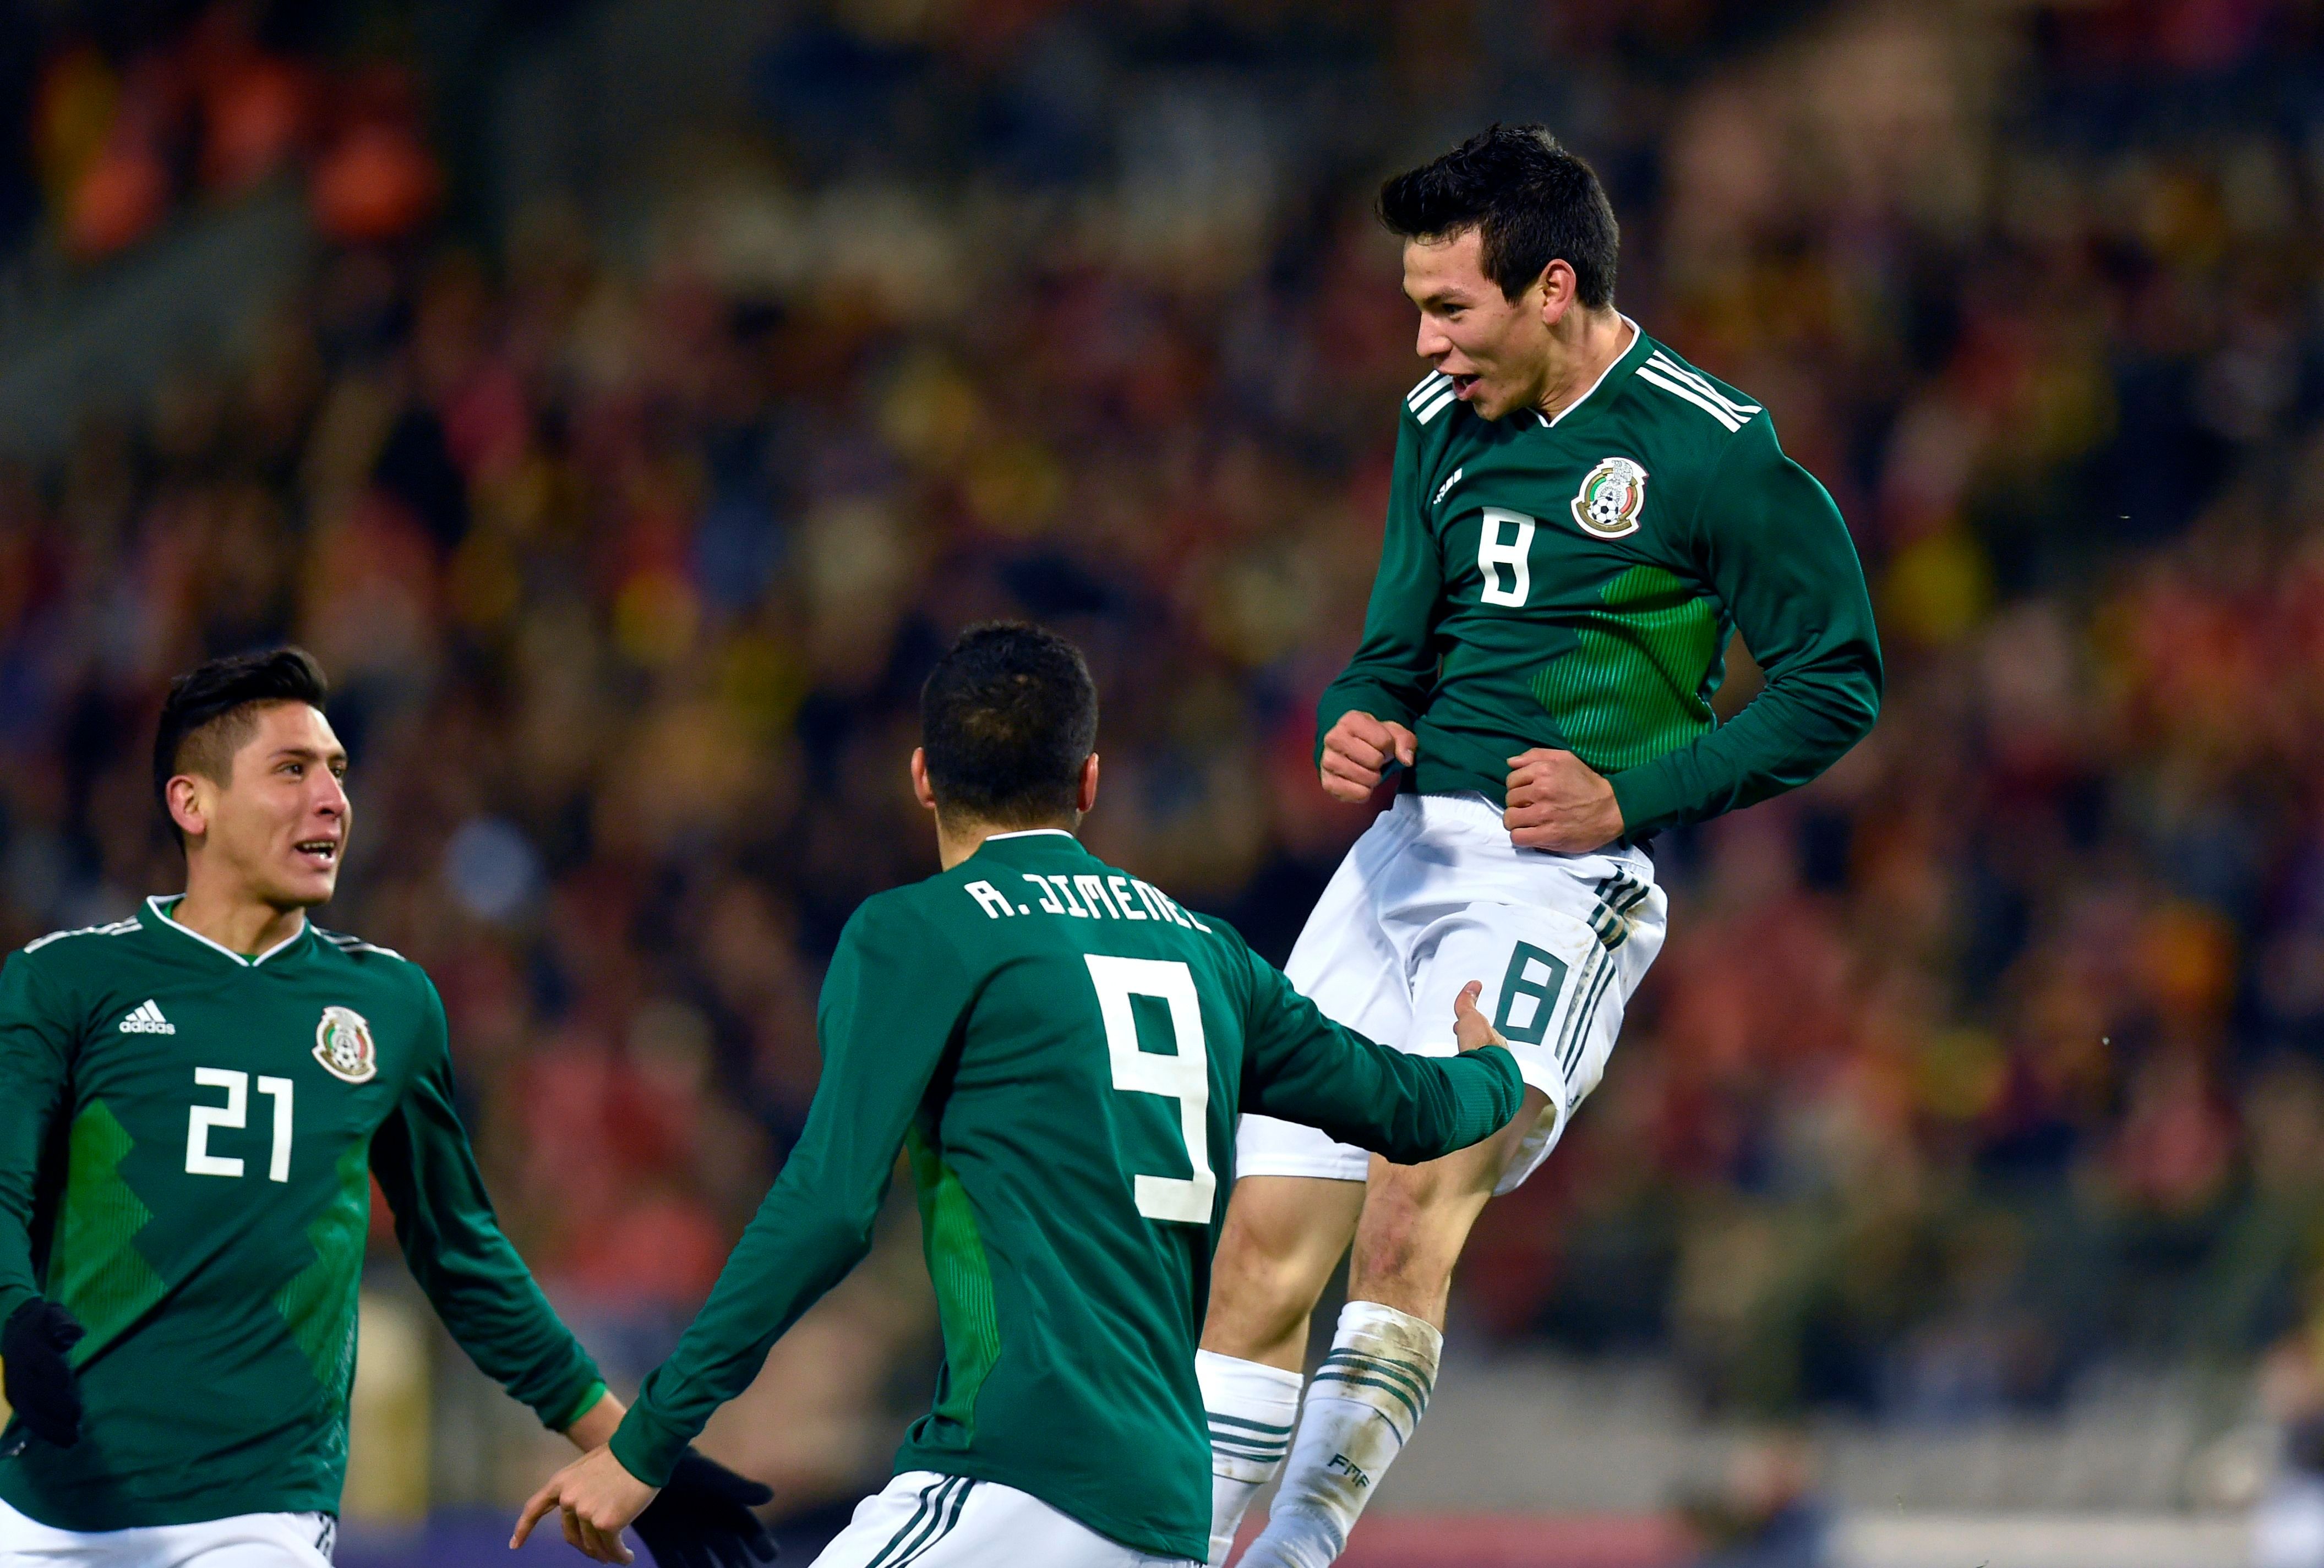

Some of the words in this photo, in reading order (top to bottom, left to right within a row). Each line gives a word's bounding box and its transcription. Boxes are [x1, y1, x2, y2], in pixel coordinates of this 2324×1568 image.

[1477, 506, 1536, 608] 8
[118, 1021, 176, 1035] adidas
[1493, 939, 1569, 1046] 8
[185, 1067, 293, 1182] 21
[1083, 953, 1216, 1224] 9
[1327, 1453, 1370, 1487] FMF
